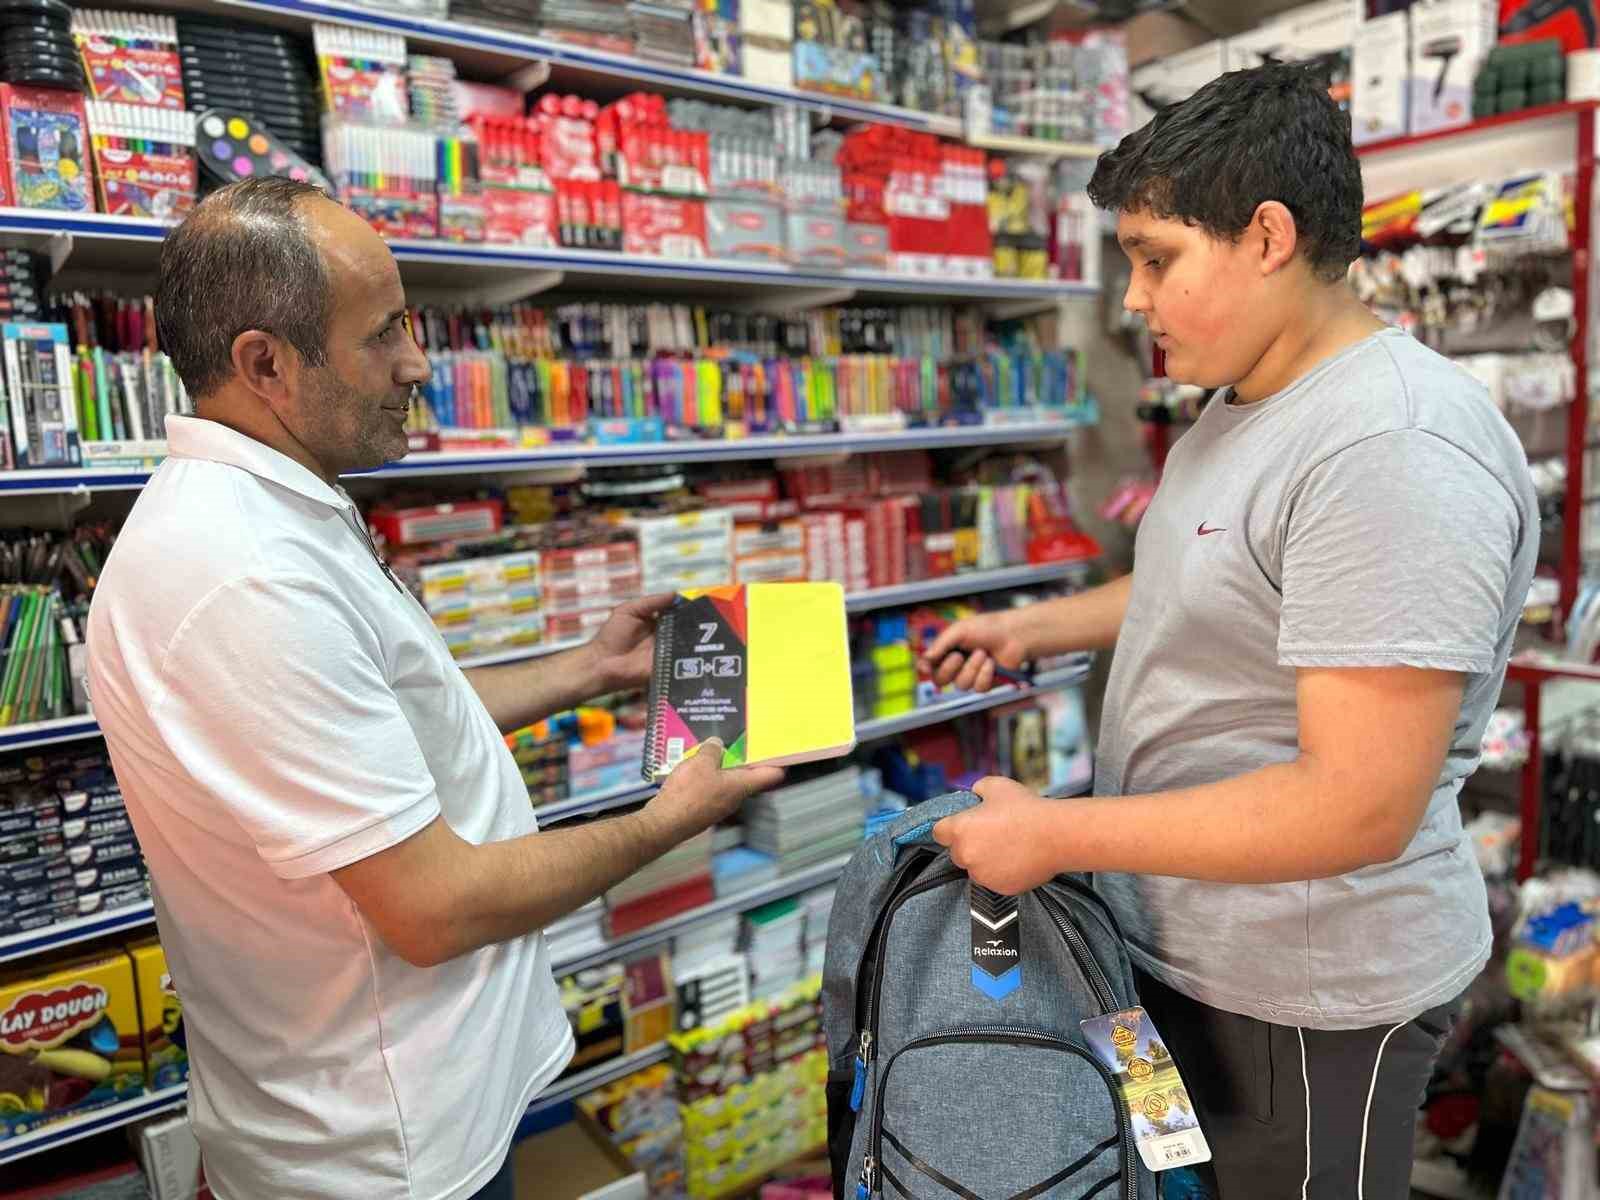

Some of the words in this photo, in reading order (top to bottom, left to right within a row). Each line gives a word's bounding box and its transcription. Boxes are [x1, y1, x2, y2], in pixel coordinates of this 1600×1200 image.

[698, 622, 718, 643] 7
[974, 947, 1018, 957] Relaxion
[0, 1010, 35, 1034] LAY
[41, 991, 107, 1025] DOUGH
